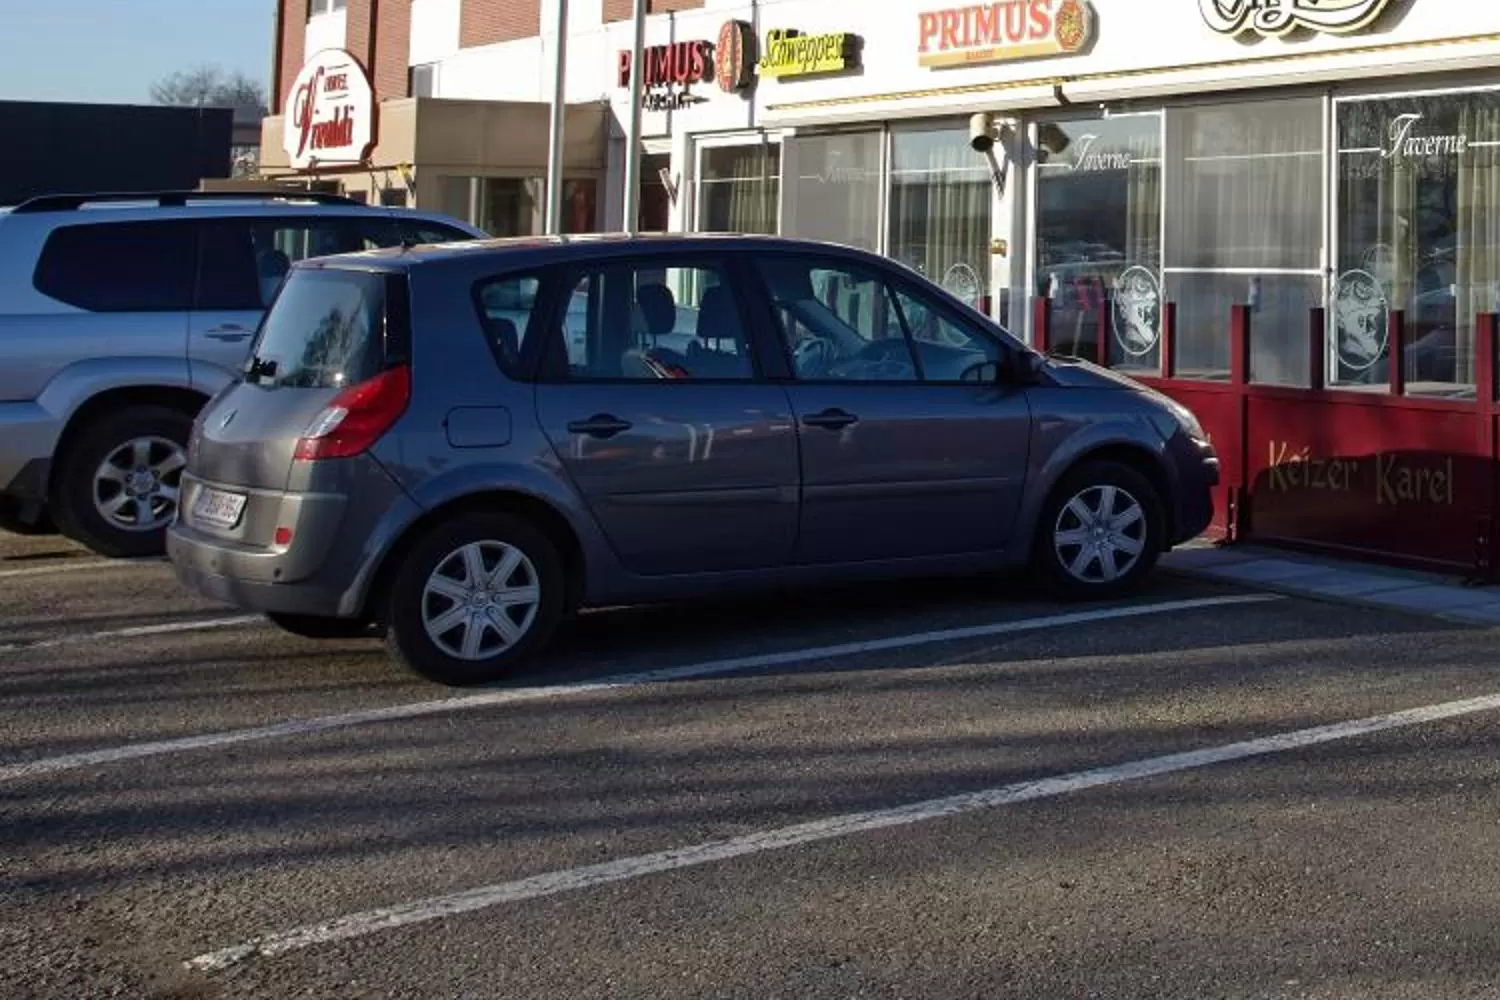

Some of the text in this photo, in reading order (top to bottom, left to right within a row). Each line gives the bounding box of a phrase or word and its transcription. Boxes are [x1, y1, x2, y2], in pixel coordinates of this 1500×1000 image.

[617, 39, 706, 88] PIMUS
[761, 28, 845, 72] Schweppes
[1380, 111, 1467, 159] Taverne
[1268, 440, 1455, 505] Keizer Karel
